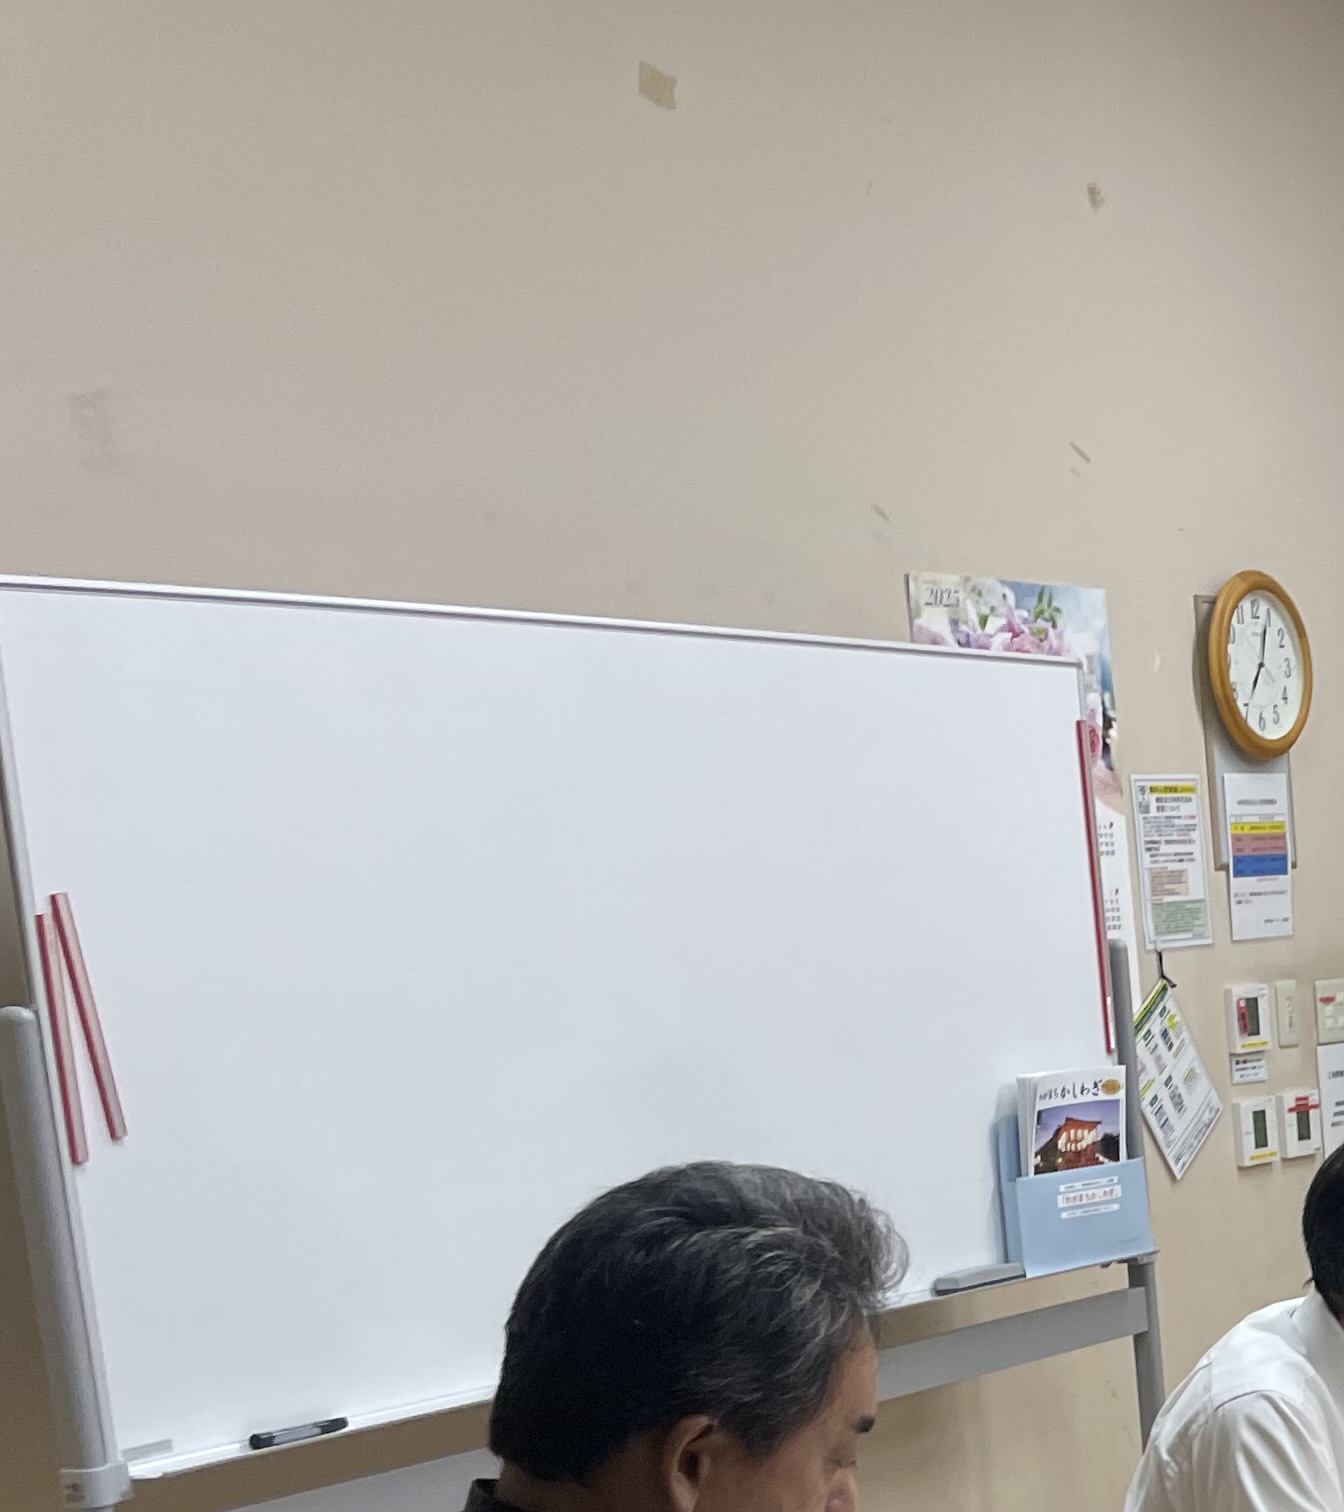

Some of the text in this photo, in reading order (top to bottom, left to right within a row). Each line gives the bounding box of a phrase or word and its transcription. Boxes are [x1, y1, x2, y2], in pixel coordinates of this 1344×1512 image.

[1236, 605, 1244, 624] 11
[1250, 599, 1260, 619] 12
[1277, 628, 1285, 648] 2
[1284, 657, 1291, 678] 3
[1281, 686, 1288, 704] 4
[1243, 703, 1250, 723] 7
[1258, 711, 1266, 731] 6
[1273, 704, 1280, 724] 5
